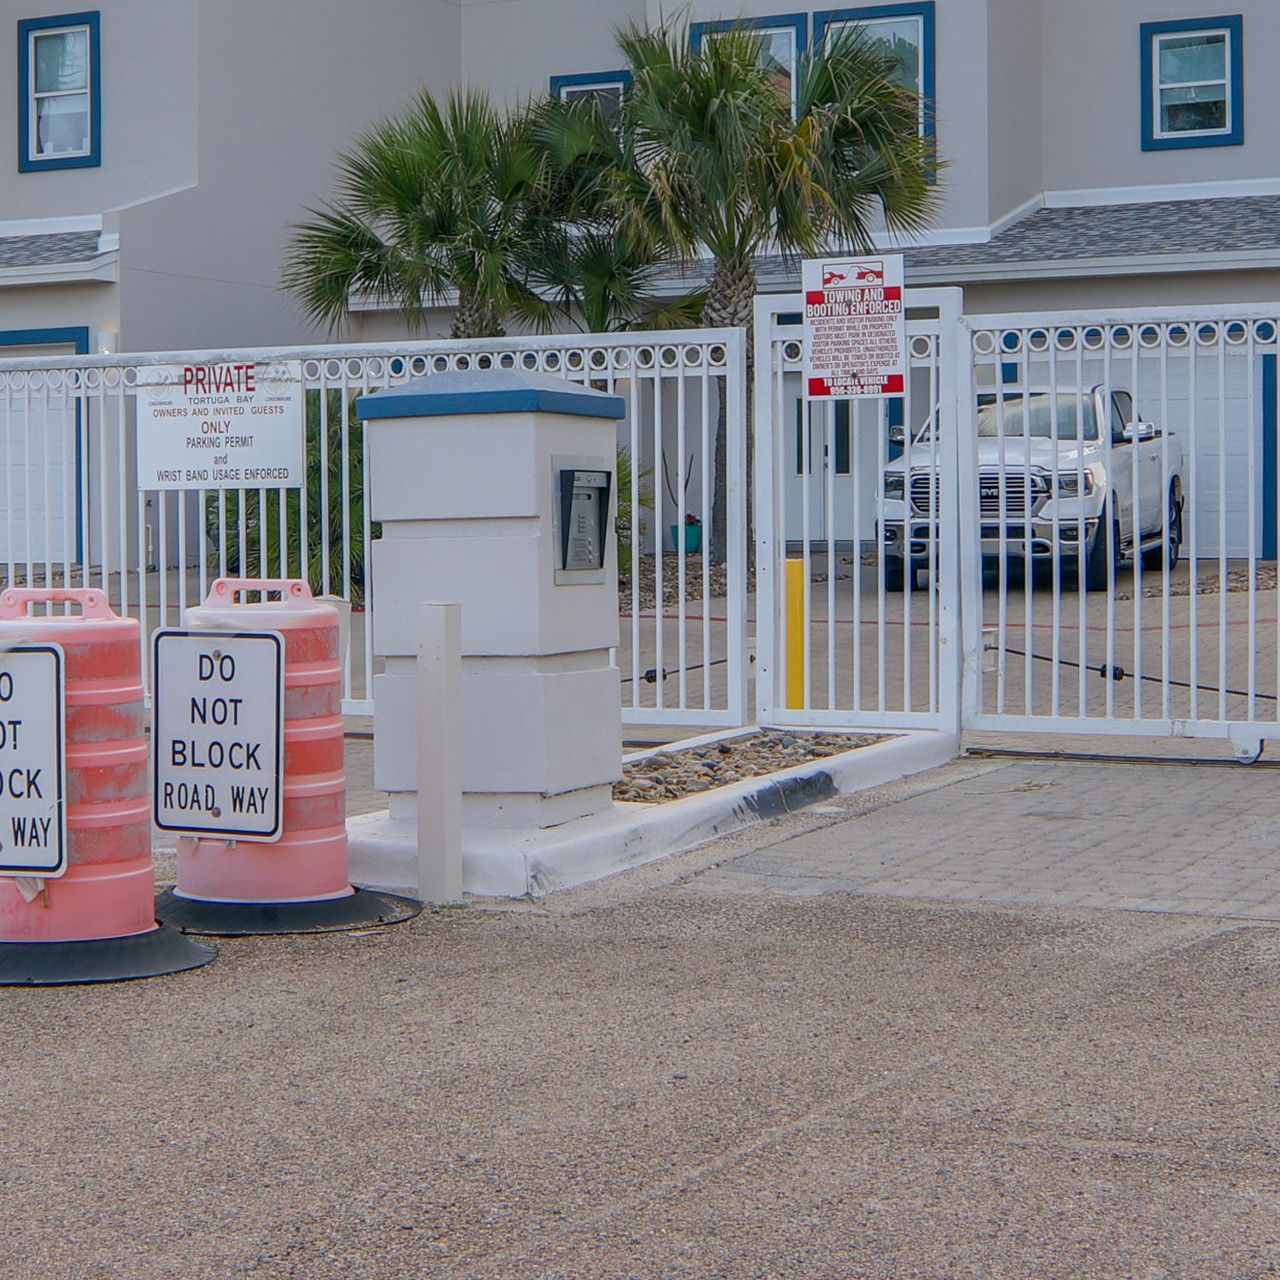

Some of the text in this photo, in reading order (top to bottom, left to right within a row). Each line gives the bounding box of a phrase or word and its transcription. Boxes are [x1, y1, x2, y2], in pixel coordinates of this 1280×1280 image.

[823, 288, 884, 304] TOWING AND
[807, 300, 901, 317] BOOTING ENFORCED
[812, 340, 829, 348] VISITOR
[184, 364, 256, 395] PRIVATE
[824, 375, 888, 387] TO LOCATE VEHICLE
[188, 395, 254, 405] TORTUGA BAY
[152, 405, 284, 418] OWNERS AND INVITED GUESTS
[201, 421, 231, 434] ONLY
[186, 436, 253, 448] PARKING PERMIT
[214, 453, 228, 465] and
[157, 468, 289, 482] WRIST BAND USAGE ENFORCED
[198, 654, 236, 684] DO
[190, 697, 242, 727] NOT
[172, 740, 262, 771] BLOCK
[164, 781, 267, 815] ROAD WAY
[11, 816, 51, 849] WAY
